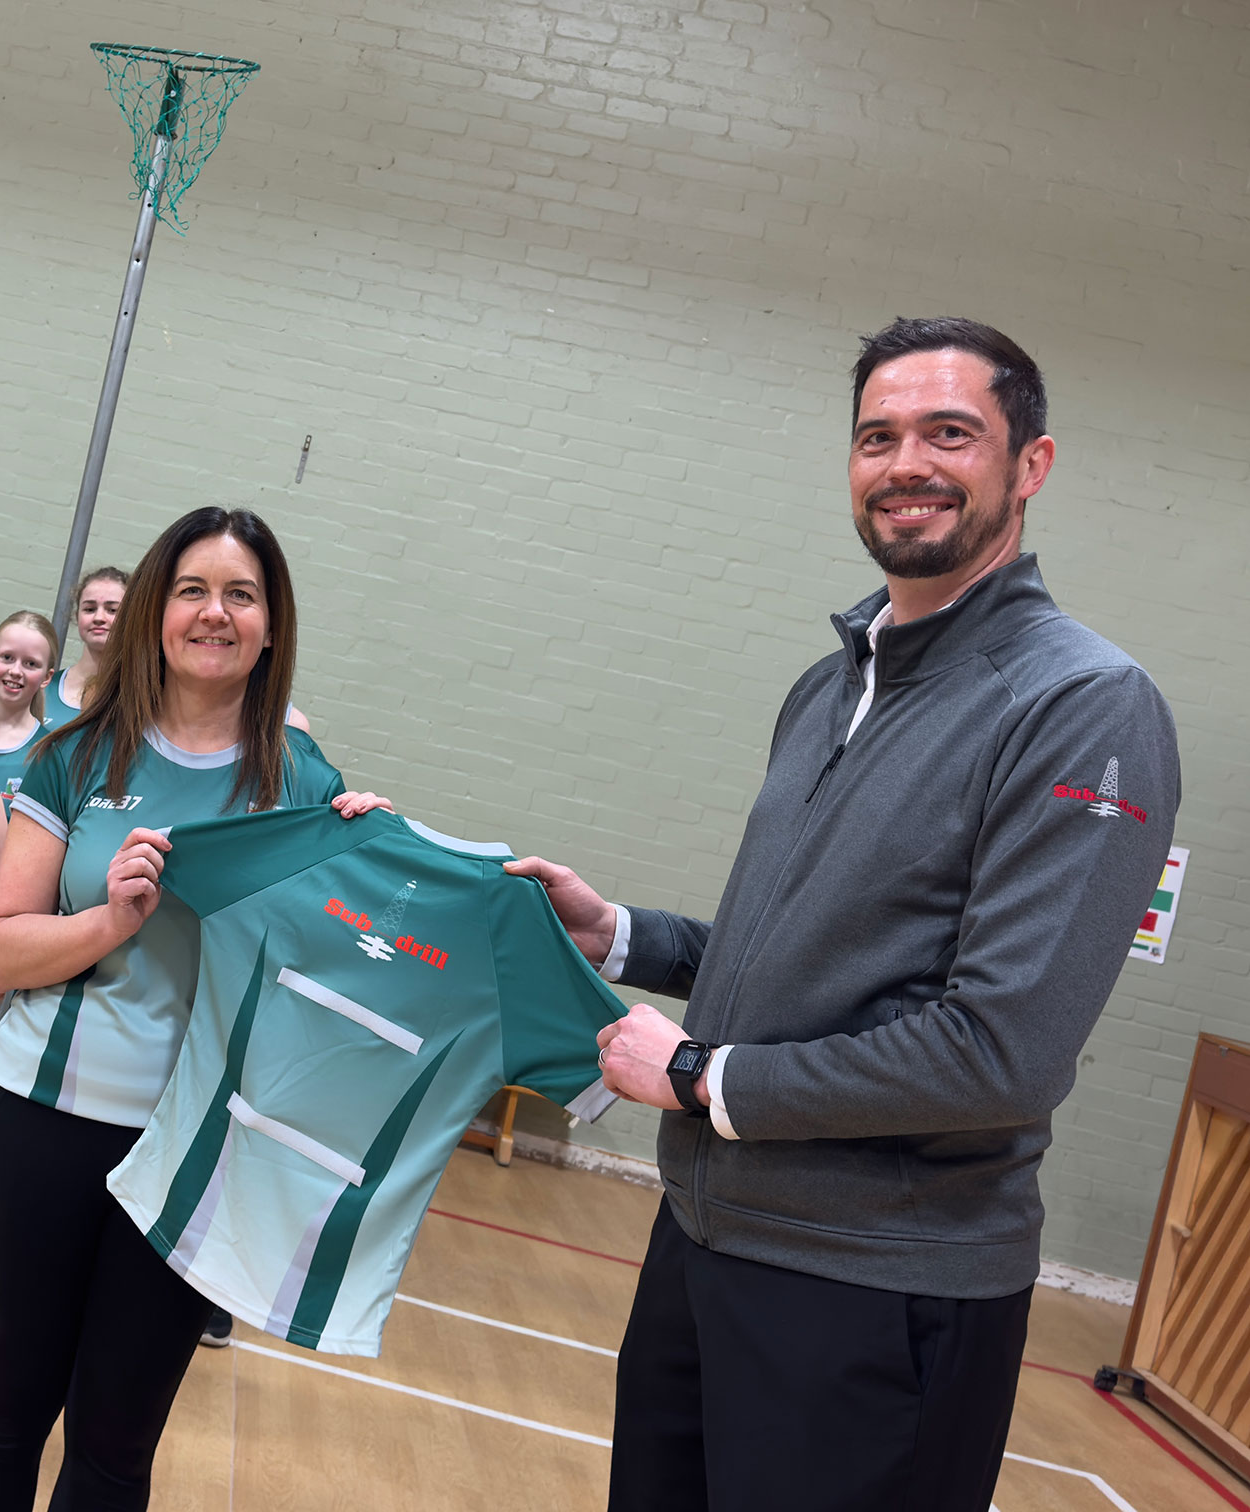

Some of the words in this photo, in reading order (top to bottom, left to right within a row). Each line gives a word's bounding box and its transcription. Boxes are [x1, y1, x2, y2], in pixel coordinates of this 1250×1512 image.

[1053, 784, 1097, 802] Sub
[323, 897, 373, 932] Sub
[395, 935, 449, 970] drill
